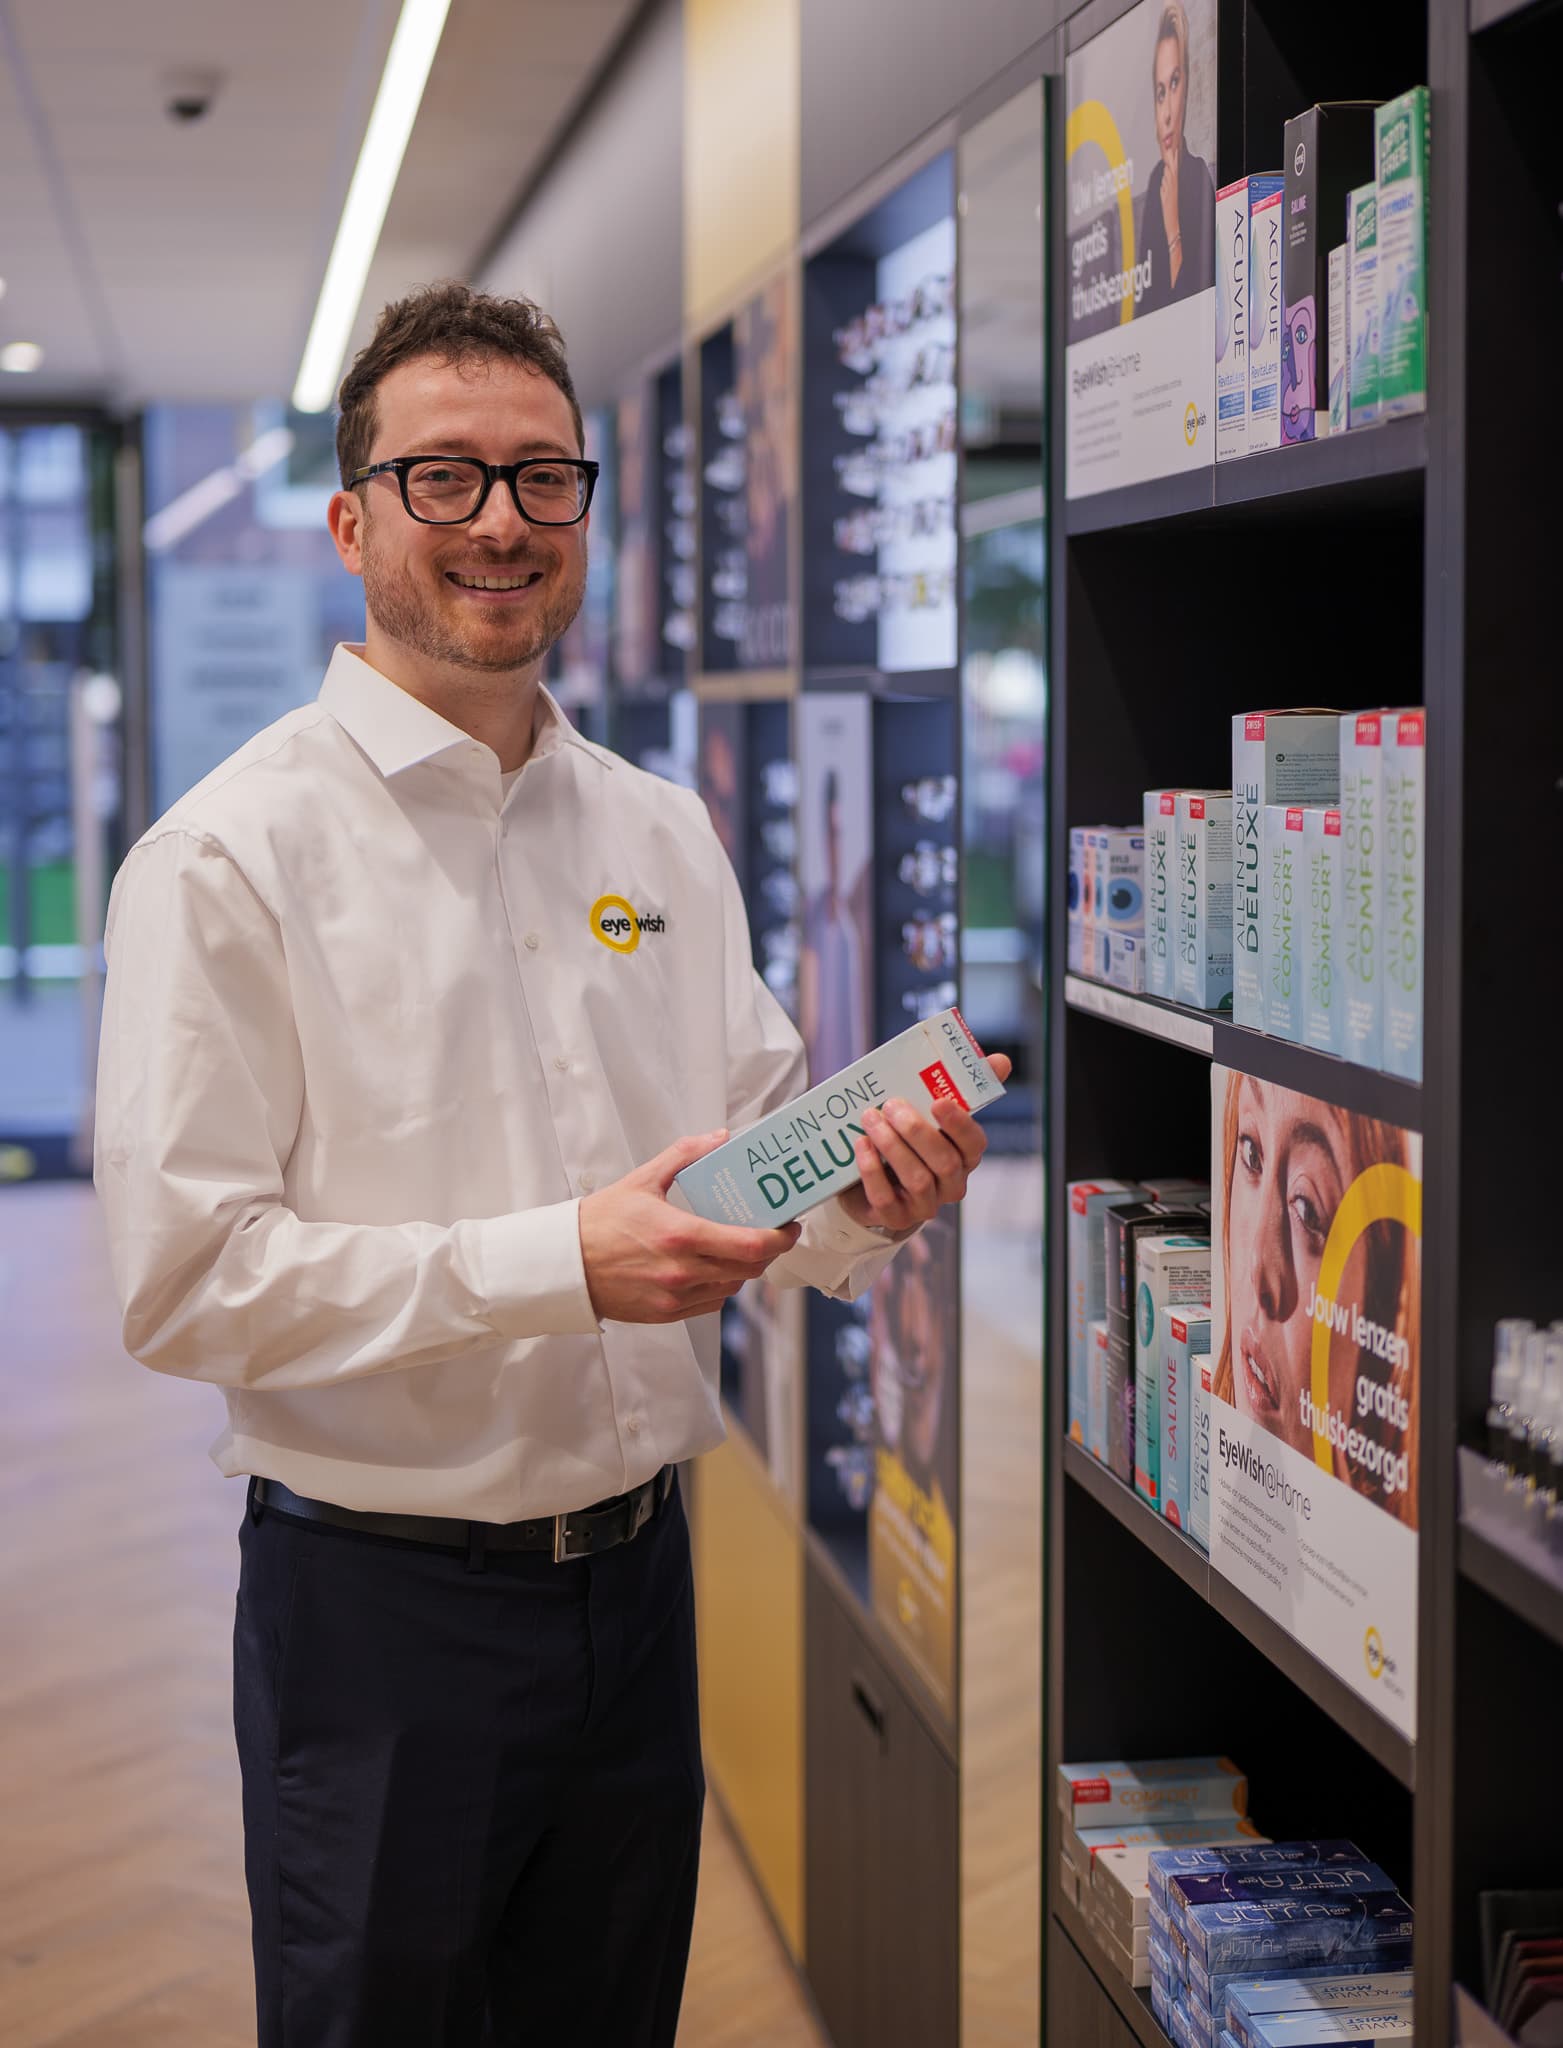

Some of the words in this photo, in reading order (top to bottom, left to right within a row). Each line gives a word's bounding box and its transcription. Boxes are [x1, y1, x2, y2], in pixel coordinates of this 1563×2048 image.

[1072, 219, 1109, 278] gratis
[1072, 249, 1152, 320] thuisbezorgd
[1233, 209, 1245, 361] ACUVUE
[1269, 219, 1278, 345] ACUVUE
[1157, 829, 1167, 958] DELUXE
[1187, 832, 1197, 965] DELUXE
[1236, 783, 1245, 950] ALL-IN-ONE
[1246, 783, 1258, 953] DELUXE
[1359, 772, 1374, 983] COMFORT
[1402, 773, 1417, 992] COMFORT
[601, 918, 631, 936] eye
[635, 913, 665, 933] wish
[1272, 847, 1281, 993] ALL-IN-ONE
[1281, 843, 1293, 998] COMFORT
[1320, 848, 1331, 1009] COMFORT
[941, 1023, 986, 1093] DELUXE
[747, 1071, 885, 1173] ALL-IN-ONE
[757, 1104, 882, 1209] DELU
[1305, 1281, 1349, 1335] Jouw
[1352, 1303, 1409, 1370] lenzen
[1167, 1355, 1177, 1461] SALINE
[1193, 1393, 1201, 1502] PEROXIDE
[1200, 1410, 1210, 1496] PLUS
[1300, 1388, 1409, 1494] thuisbezorgd
[1356, 1375, 1409, 1431] gratis
[1219, 1428, 1312, 1520] EyeWish@Home
[1119, 1787, 1200, 1806] COMFORT
[1215, 1904, 1332, 1924] ULTRA
[1323, 1984, 1372, 1993] MOIST
[1327, 1989, 1389, 2000] ACUVUE
[1346, 2015, 1399, 2024] MOIST
